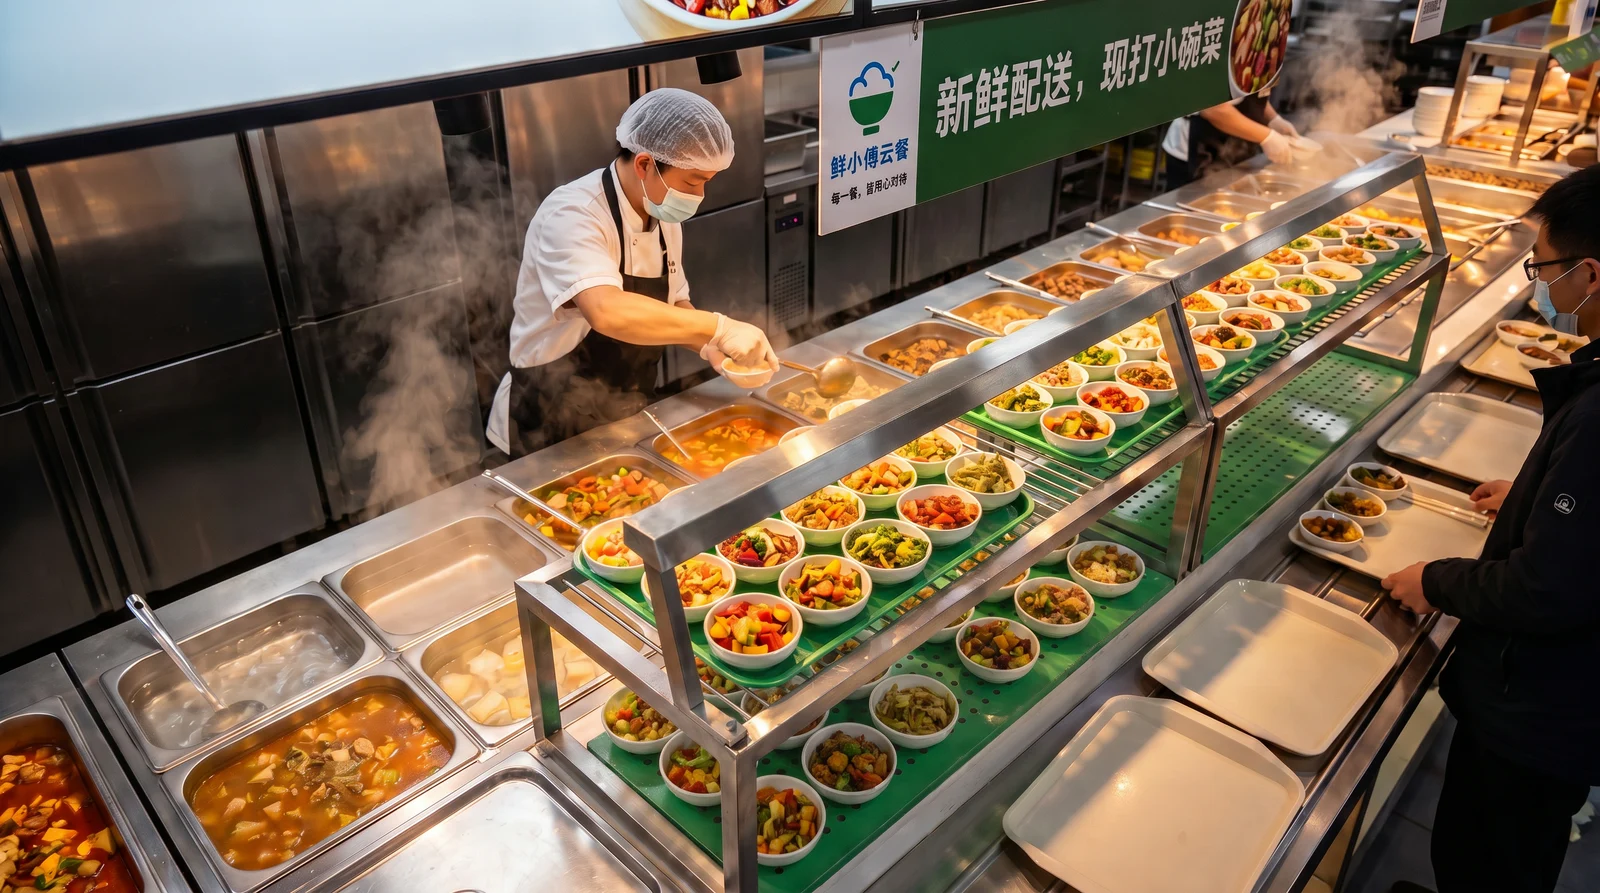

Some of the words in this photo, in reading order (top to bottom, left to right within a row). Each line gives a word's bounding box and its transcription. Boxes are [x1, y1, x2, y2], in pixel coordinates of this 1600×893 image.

[935, 16, 1225, 138] 新鲜配送，现打小碗菜
[830, 137, 909, 180] 鲜小傅云餐
[830, 172, 908, 205] 每一餐，皆用心对待
